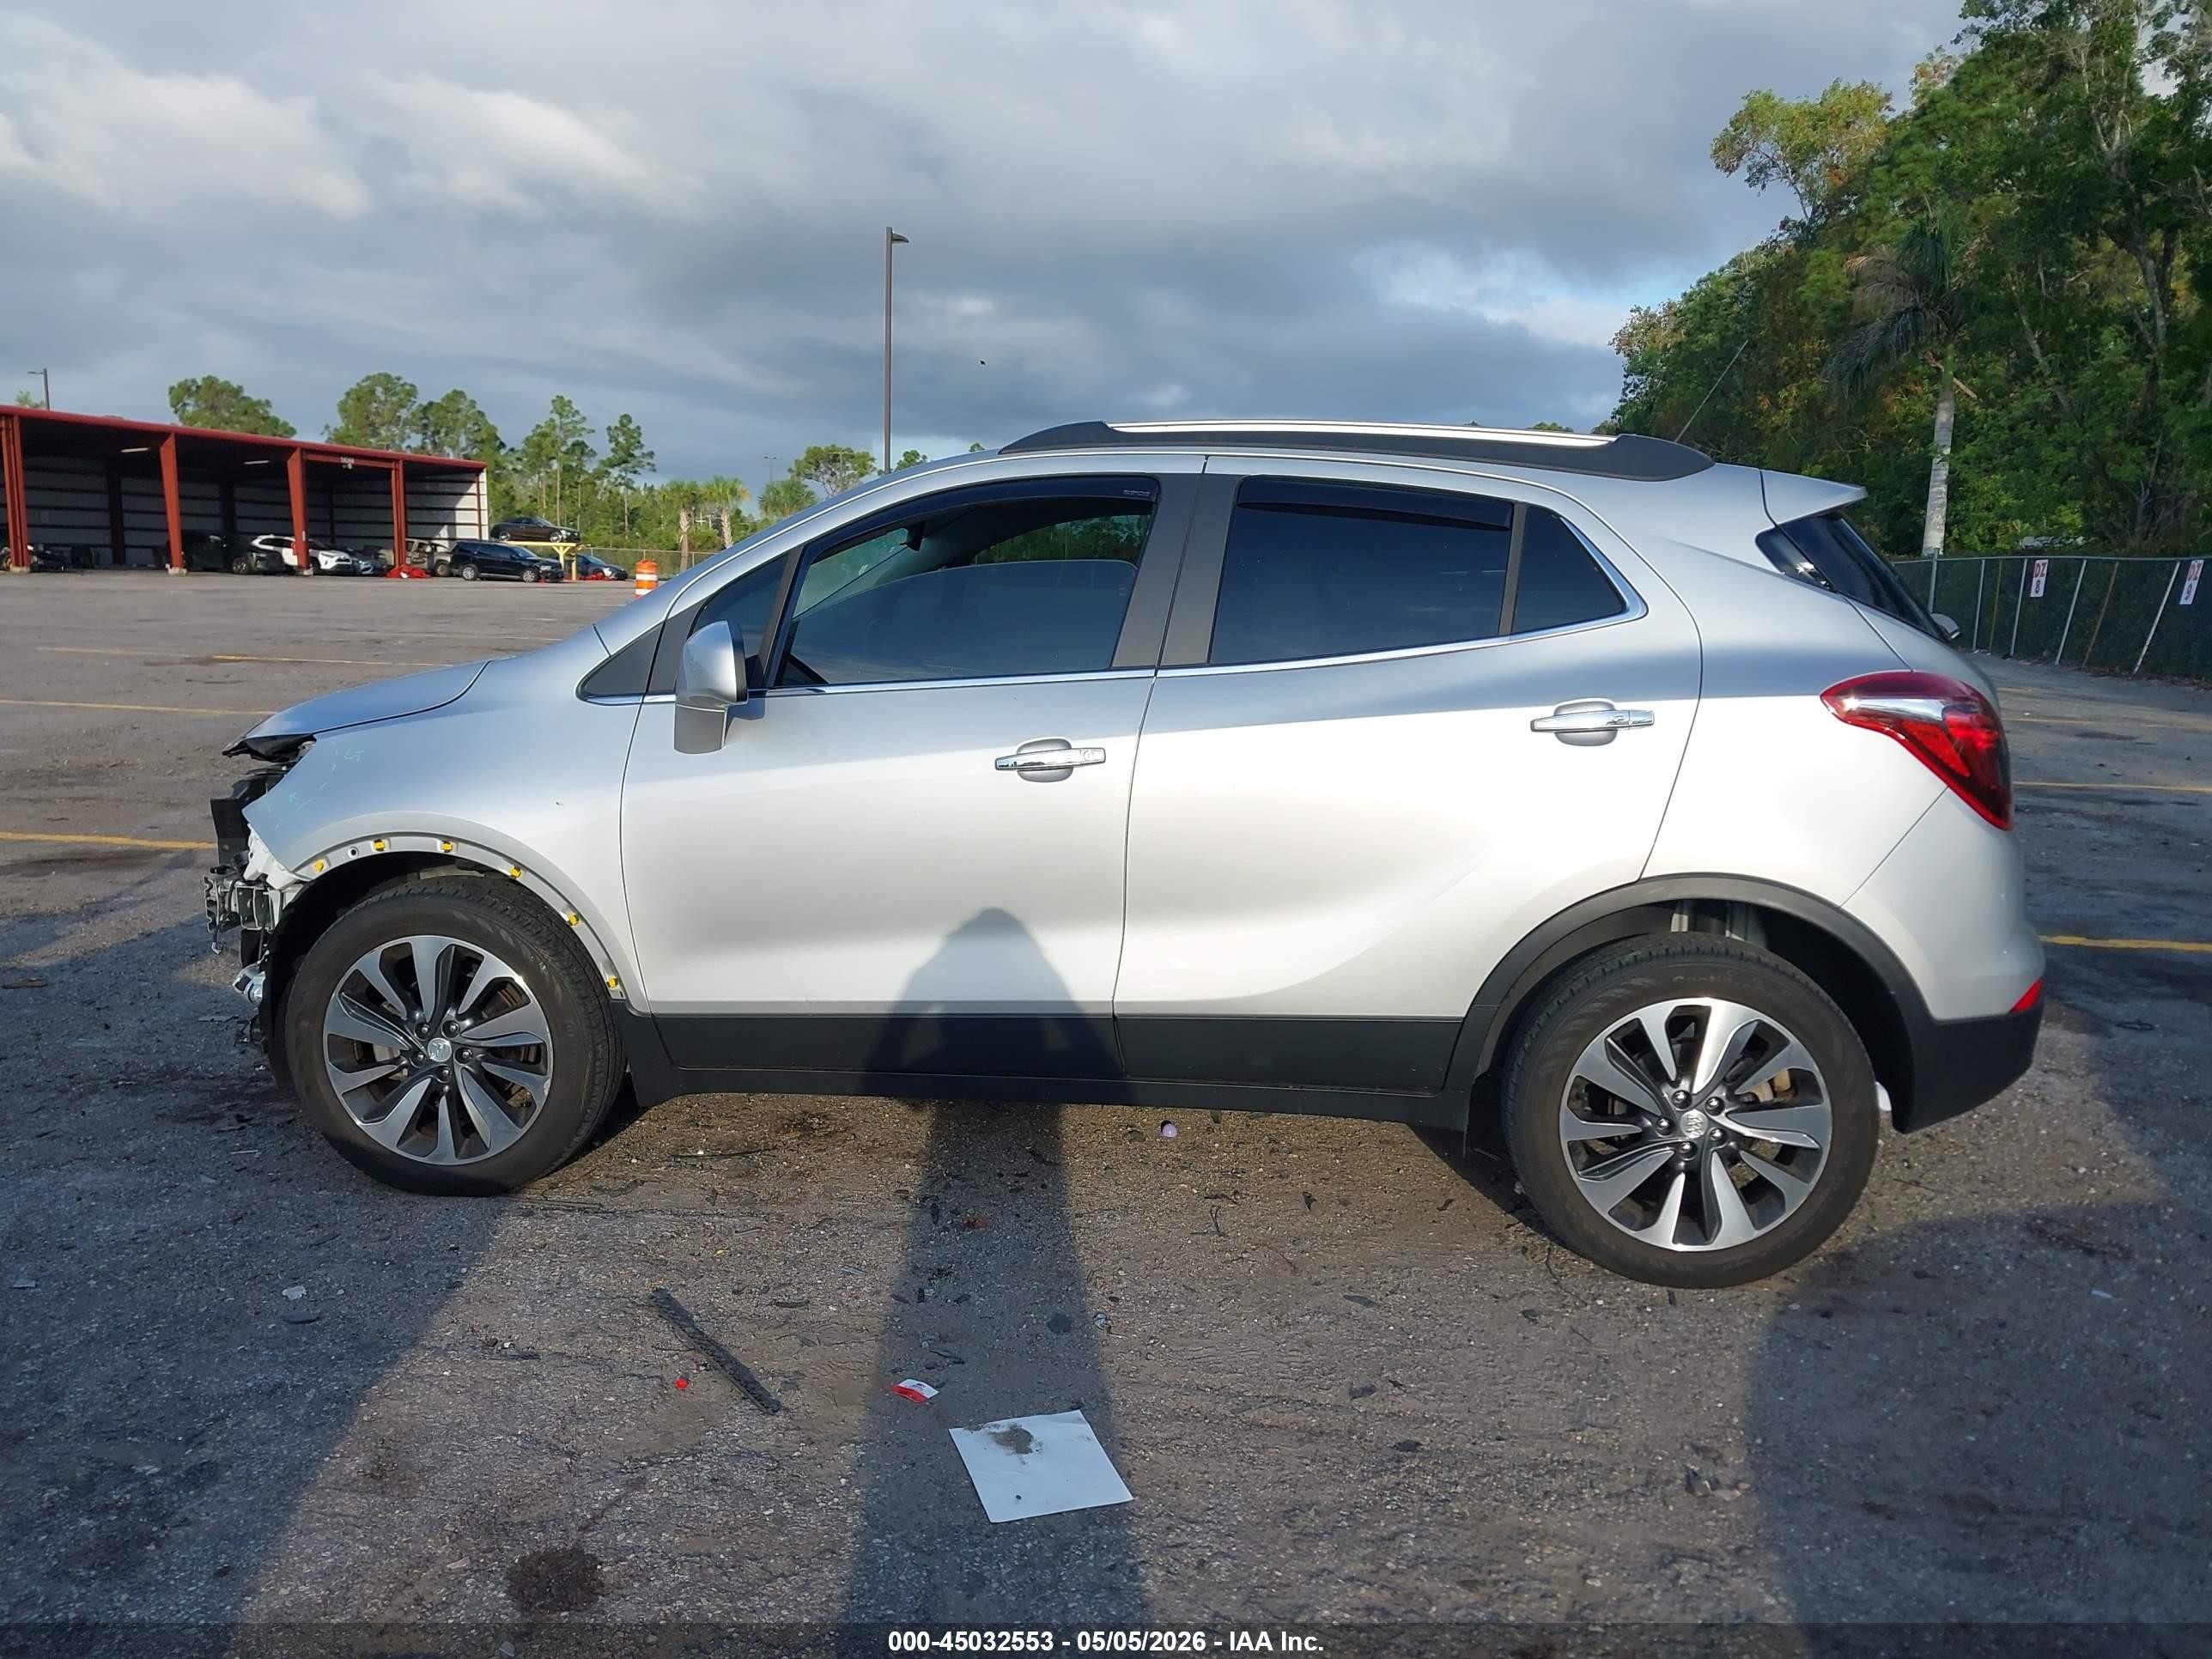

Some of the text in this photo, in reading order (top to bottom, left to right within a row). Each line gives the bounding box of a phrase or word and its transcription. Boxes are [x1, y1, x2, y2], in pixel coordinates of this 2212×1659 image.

[2033, 562, 2048, 578] DZ
[2188, 562, 2203, 582] DZ
[2034, 579, 2041, 594] 8
[2185, 584, 2192, 601] 9
